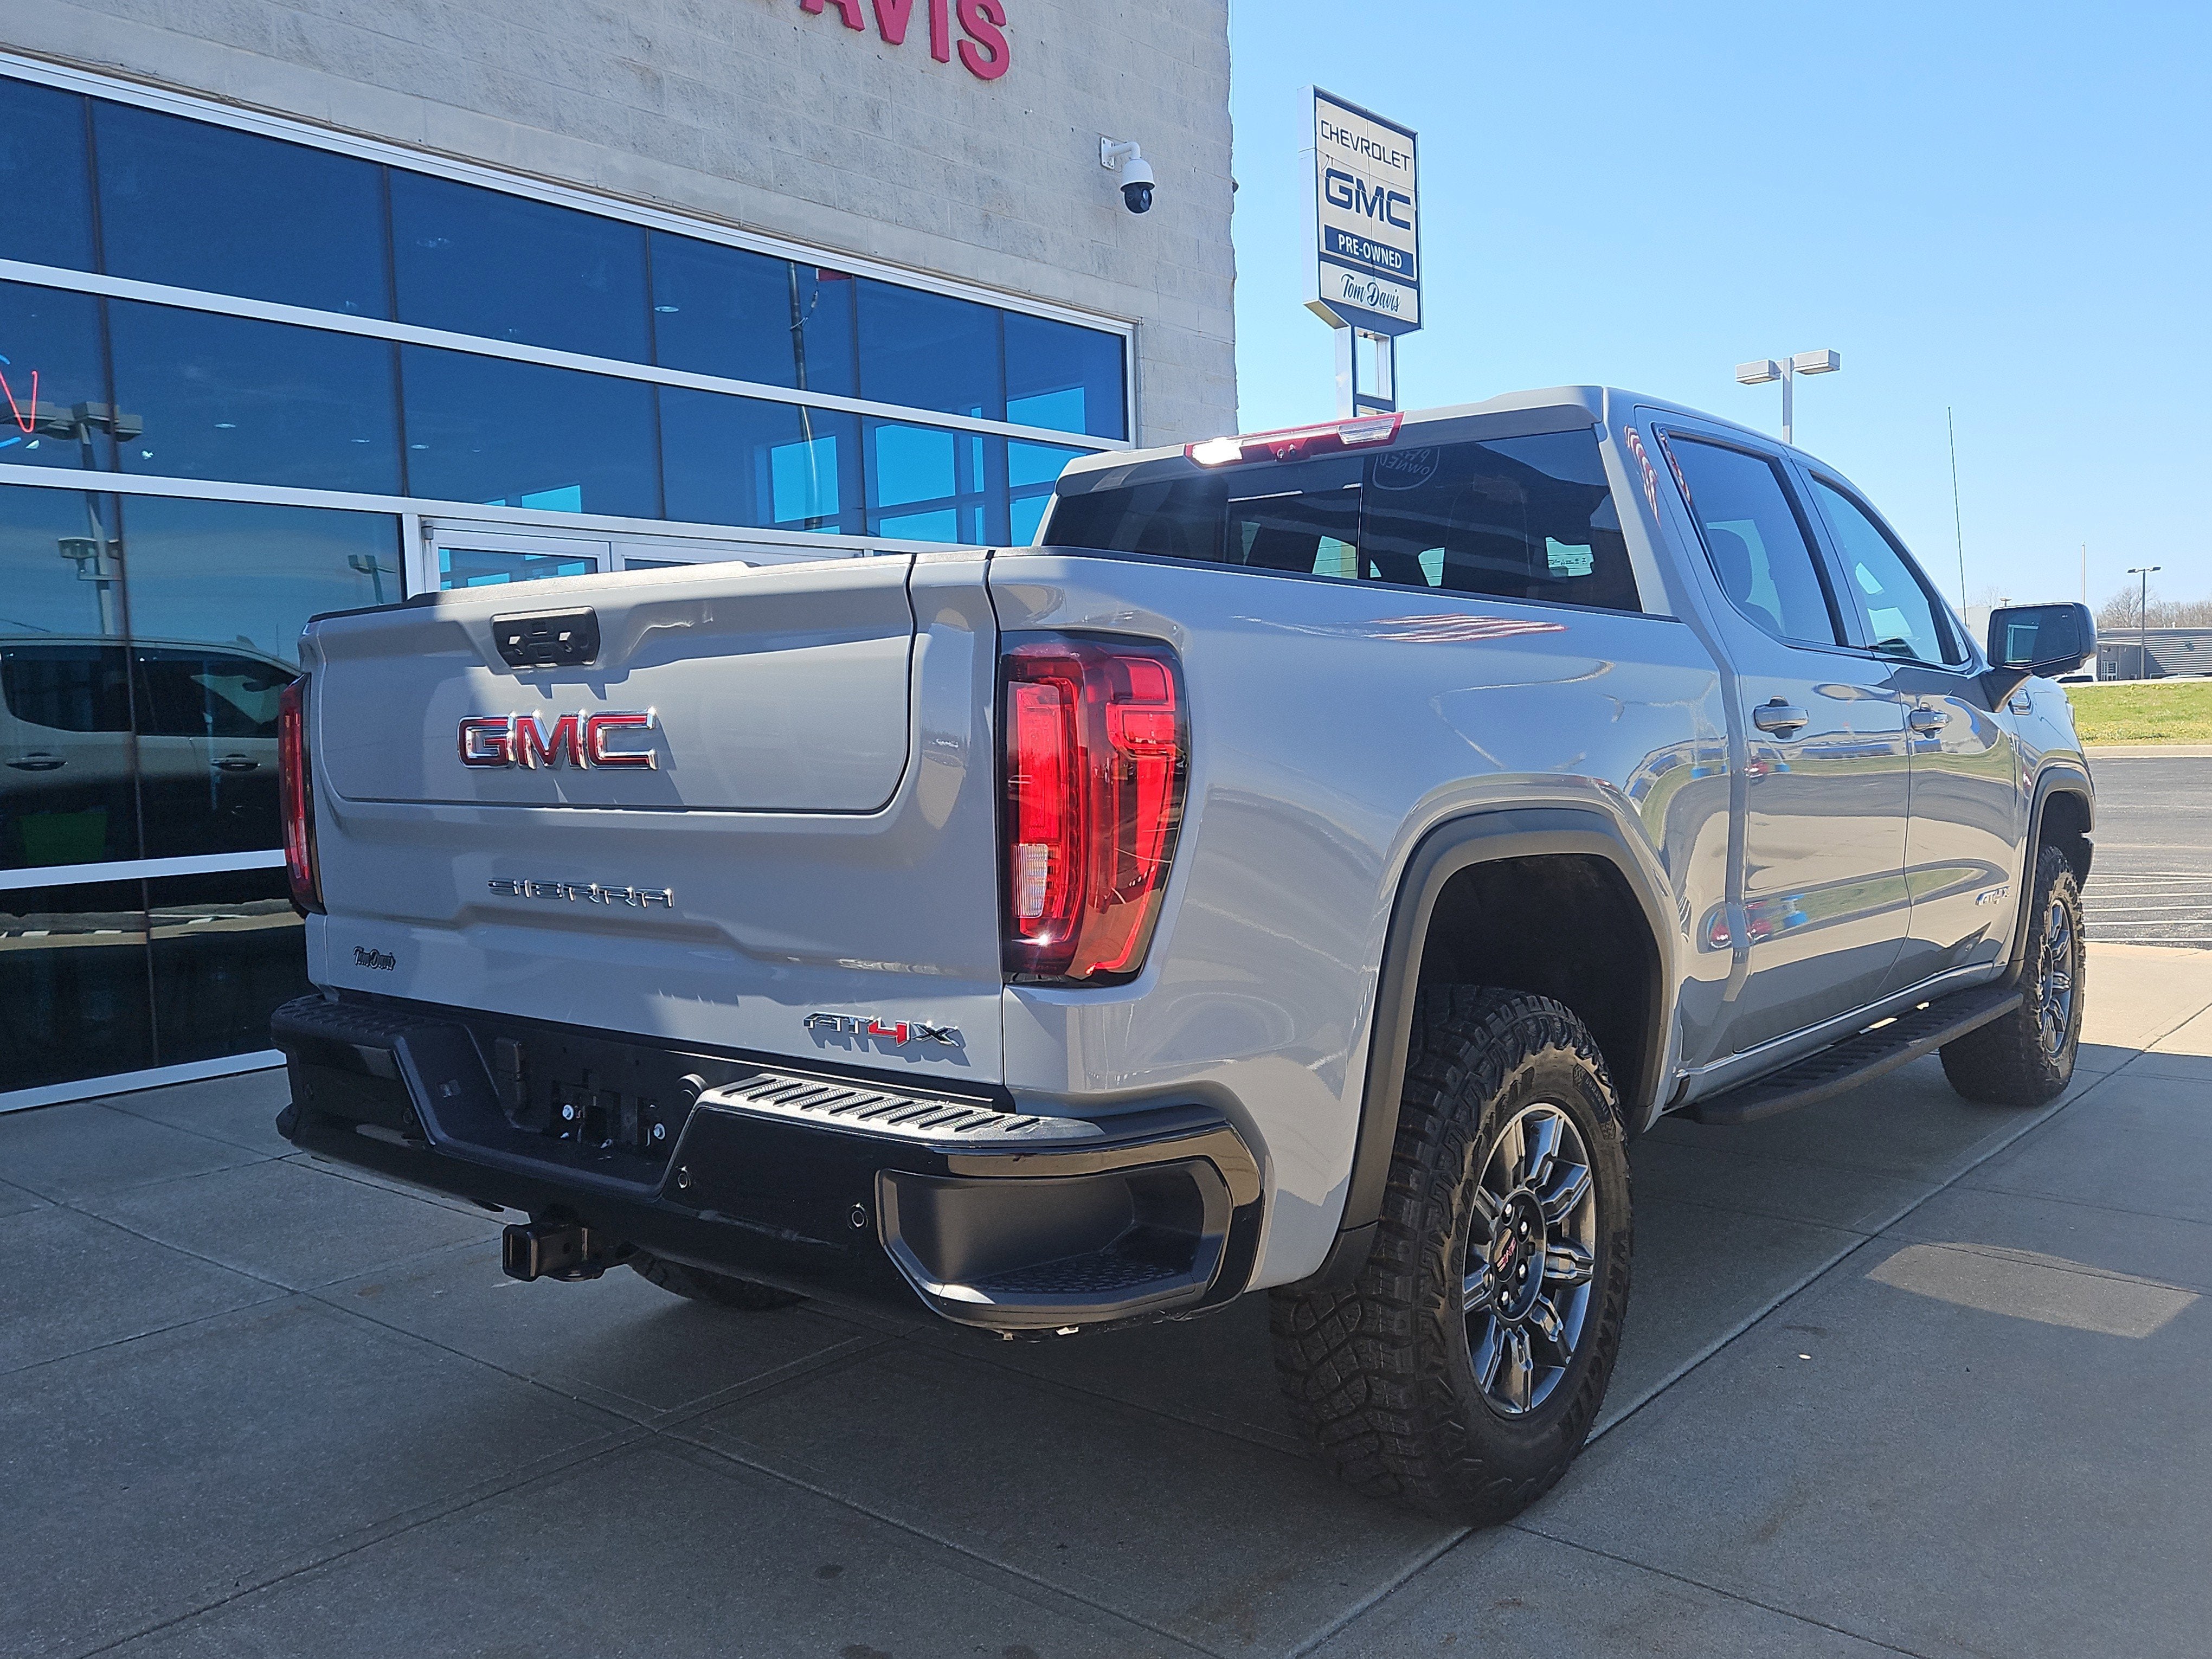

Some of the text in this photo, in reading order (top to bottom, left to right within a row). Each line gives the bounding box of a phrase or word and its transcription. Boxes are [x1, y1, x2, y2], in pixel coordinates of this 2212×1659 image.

[1320, 119, 1411, 171] CHEVROLET
[1324, 166, 1411, 232] GMC
[1338, 233, 1403, 269] PRE-OWNED
[1341, 273, 1401, 313] Tom Davis
[456, 706, 658, 770] GMC
[487, 877, 674, 909] SIERRA
[802, 1011, 960, 1048] AT4X
